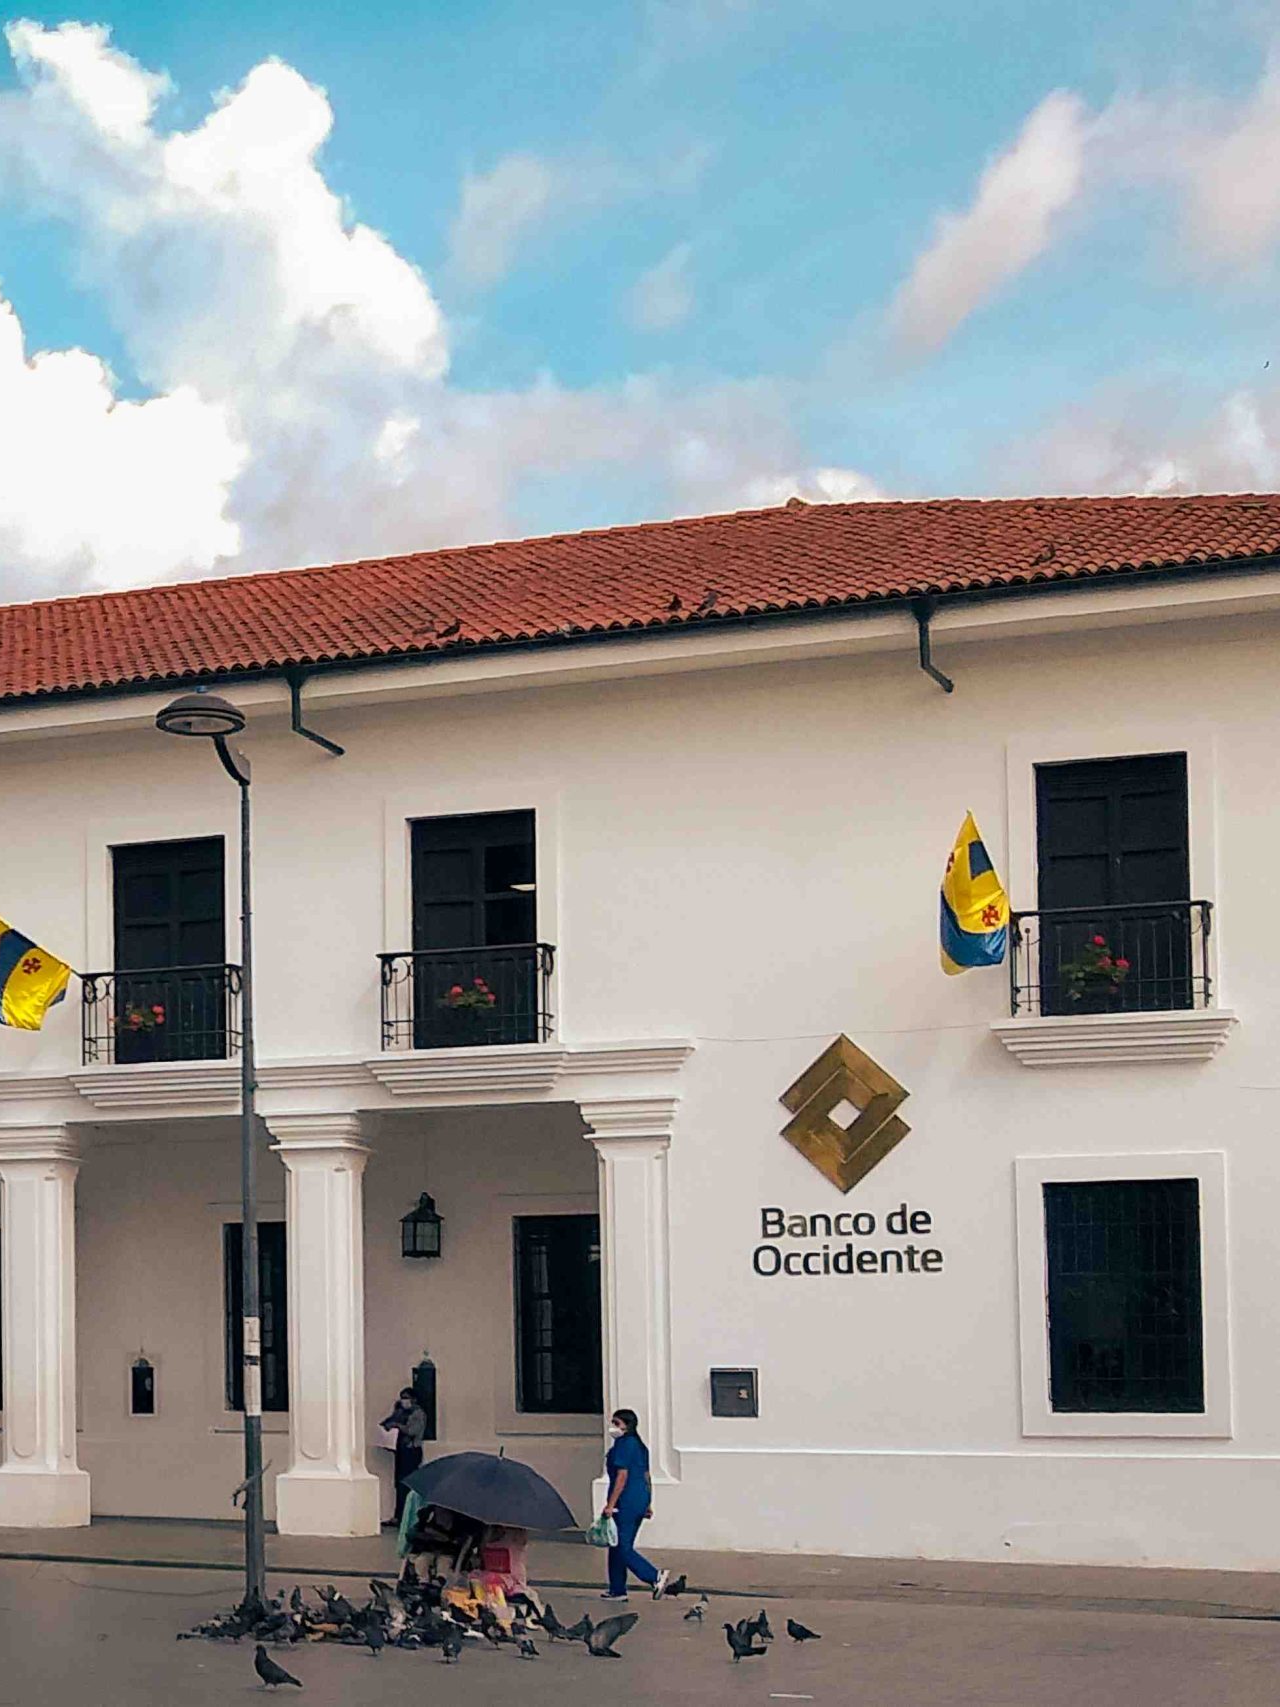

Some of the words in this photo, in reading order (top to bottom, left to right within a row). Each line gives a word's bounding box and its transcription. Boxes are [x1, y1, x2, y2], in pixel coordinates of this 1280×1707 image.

[761, 1207, 876, 1238] Banco
[886, 1203, 932, 1234] de
[753, 1243, 943, 1277] Occidente
